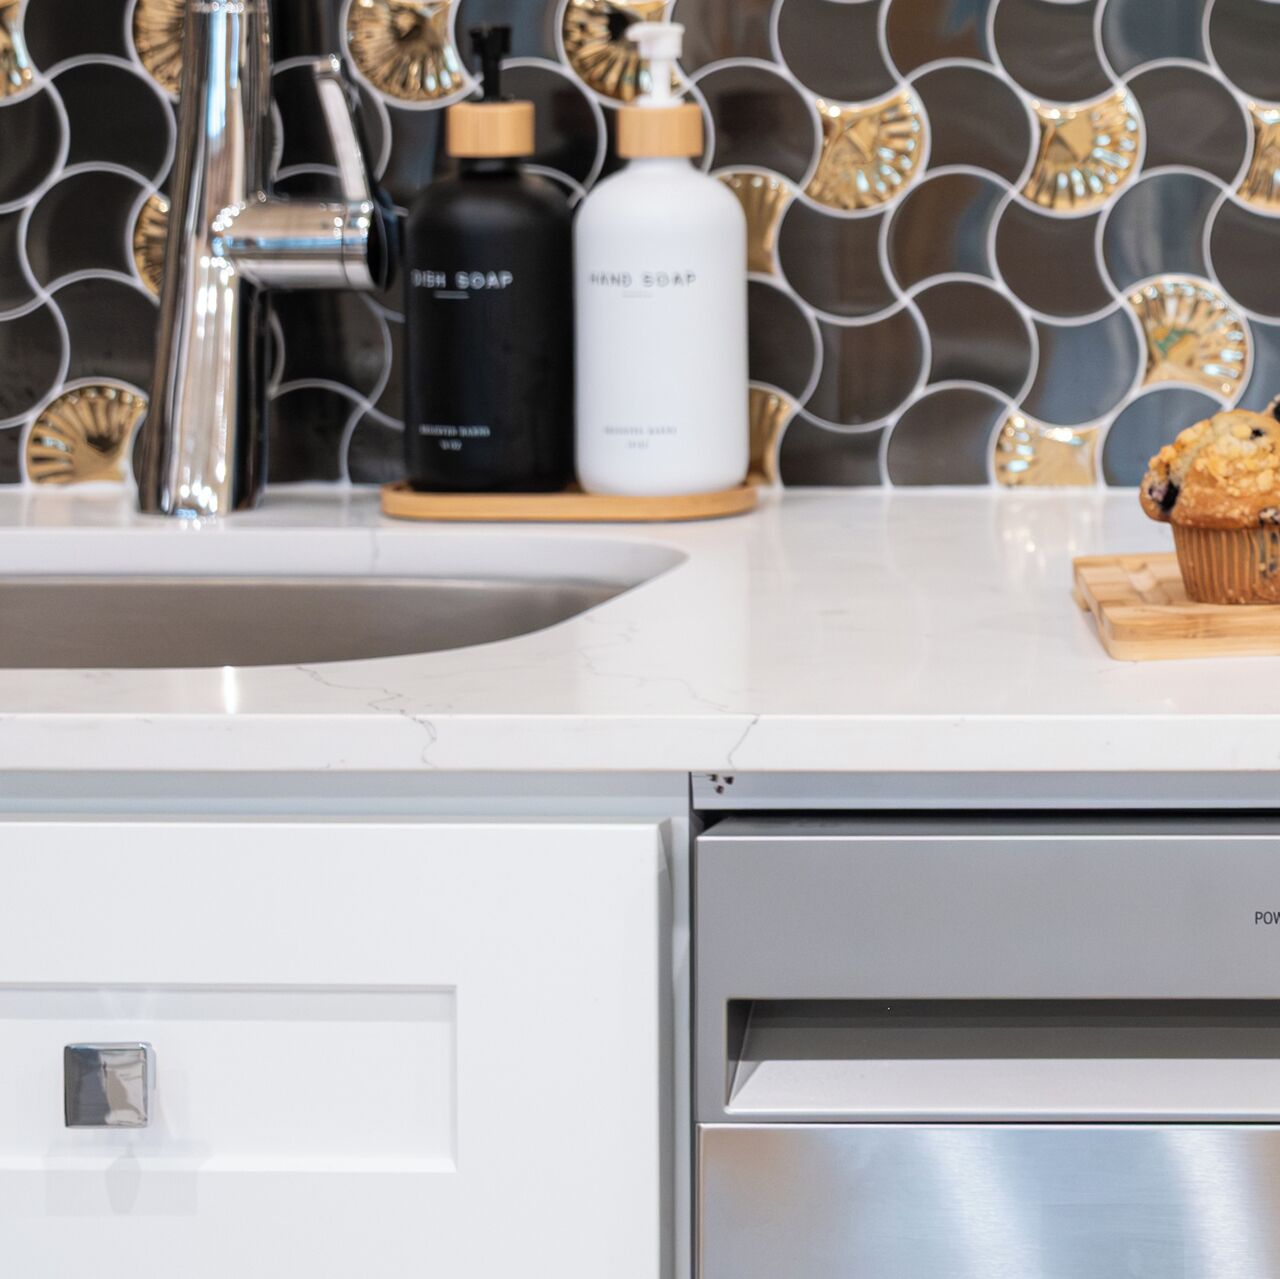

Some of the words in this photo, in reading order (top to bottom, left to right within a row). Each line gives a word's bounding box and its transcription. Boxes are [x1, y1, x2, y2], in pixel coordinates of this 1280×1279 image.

[455, 270, 514, 290] SOAP
[591, 270, 633, 289] HAND
[641, 270, 697, 289] SOAP
